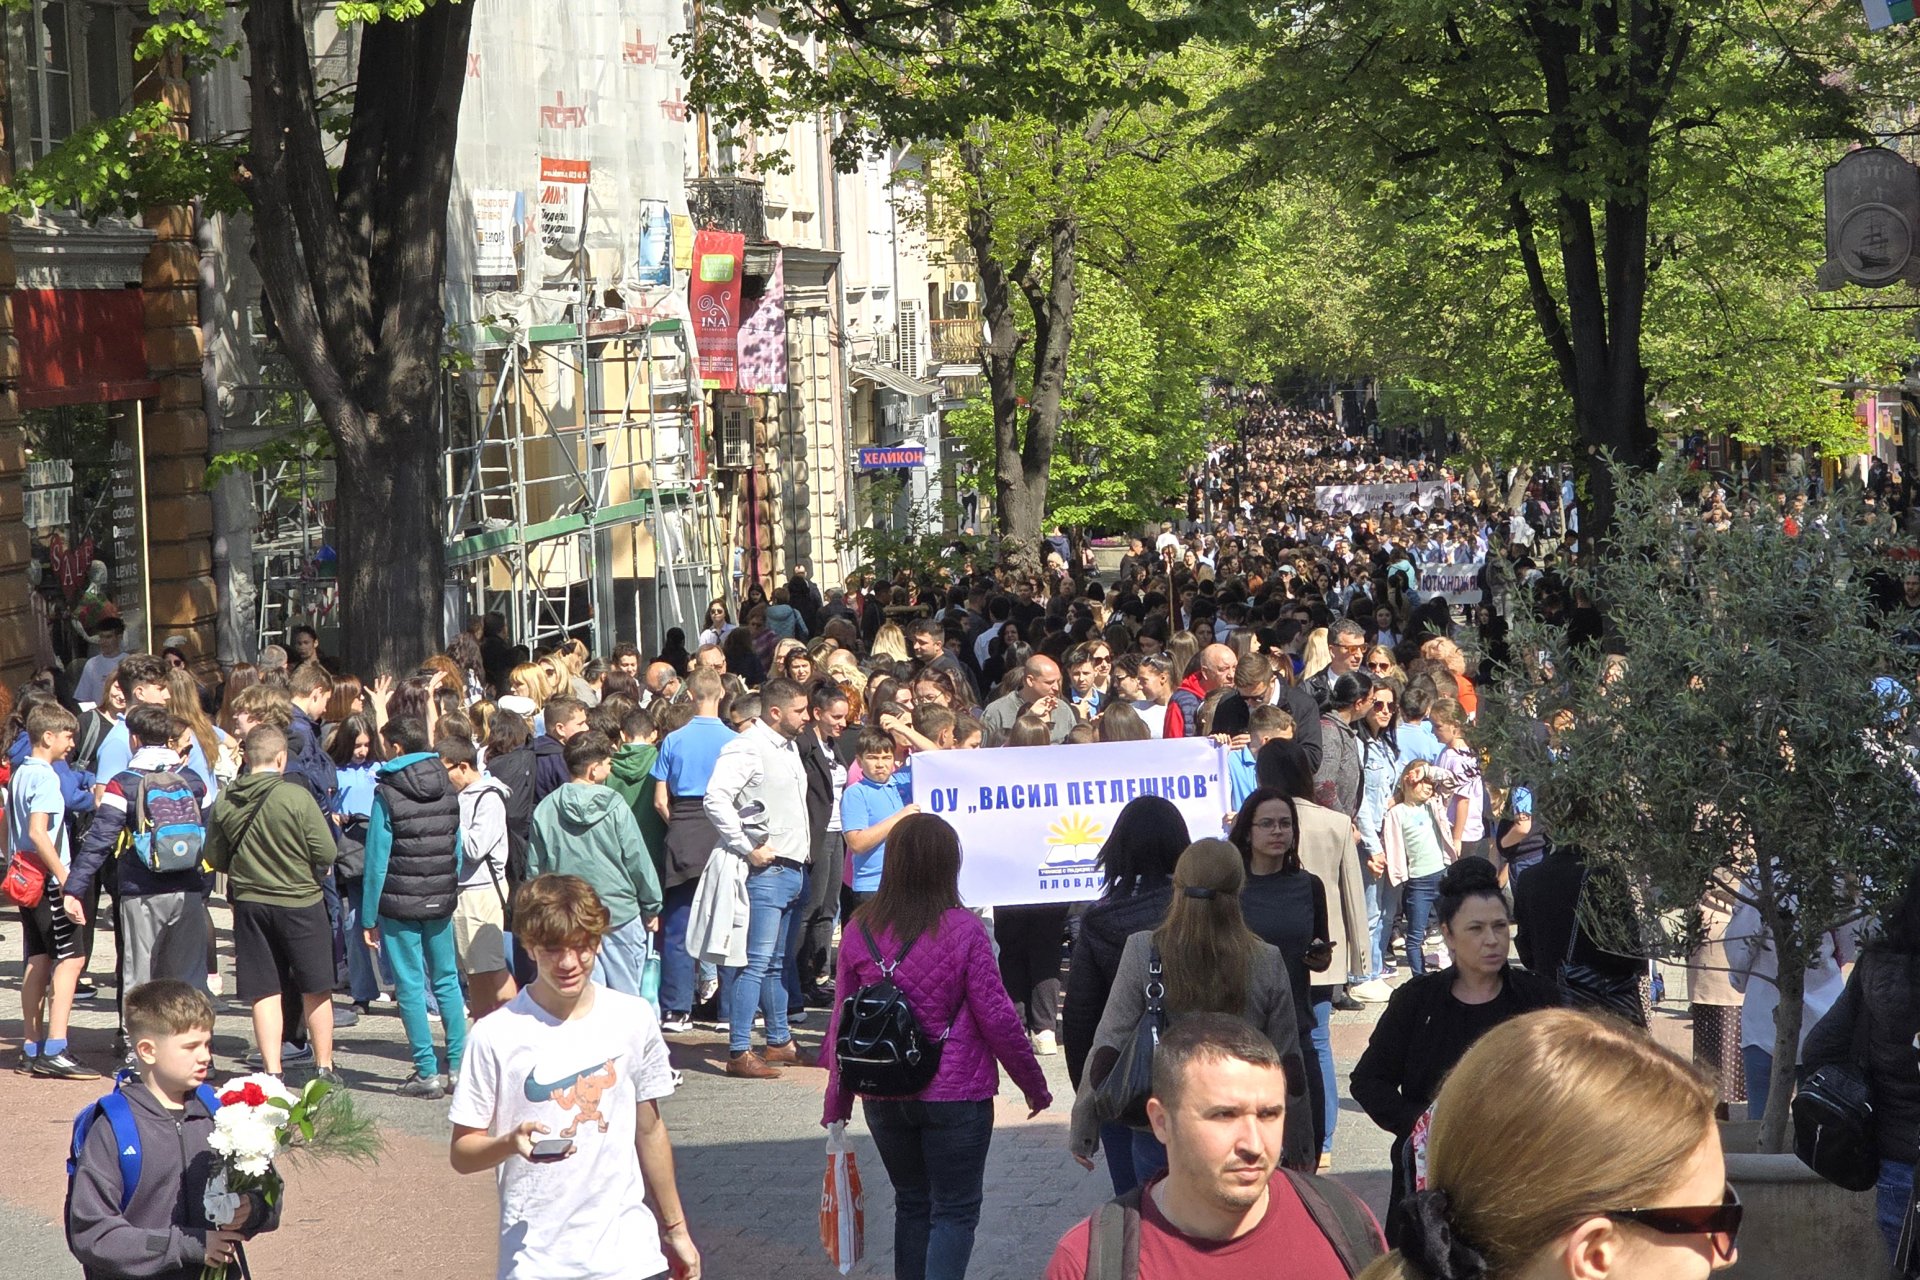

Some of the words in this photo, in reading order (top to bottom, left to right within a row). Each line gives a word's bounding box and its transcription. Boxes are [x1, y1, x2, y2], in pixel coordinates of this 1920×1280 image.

[701, 317, 726, 327] INA
[864, 451, 923, 464] ХЕЛИКОН
[30, 458, 74, 488] BRANDS
[52, 545, 92, 586] SALE
[1421, 574, 1478, 595] ЮТЮНДЖЯ
[931, 788, 958, 813] ОУ
[968, 781, 1058, 814] „ВАСИЛ
[1040, 877, 1104, 890] ПЛОВДИ
